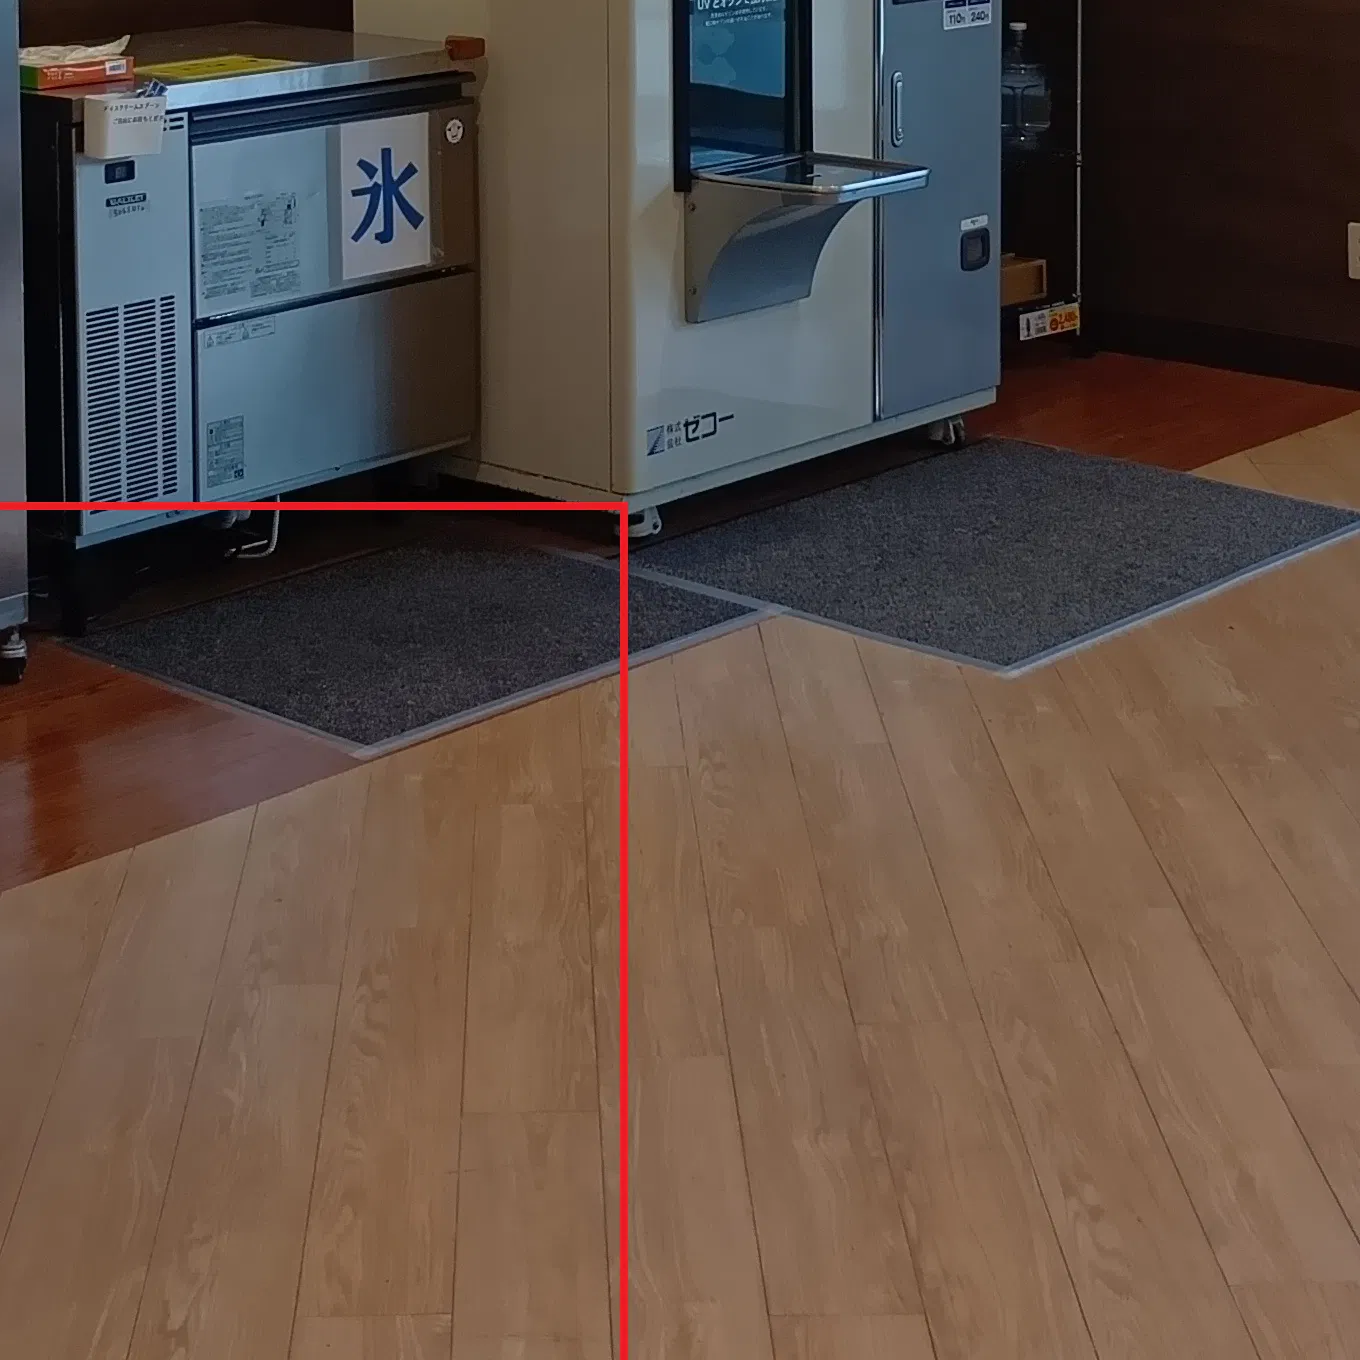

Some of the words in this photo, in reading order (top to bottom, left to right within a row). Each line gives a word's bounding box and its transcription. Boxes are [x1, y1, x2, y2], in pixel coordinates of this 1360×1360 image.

[350, 147, 424, 244] 氷
[683, 411, 734, 442] ゼコー
